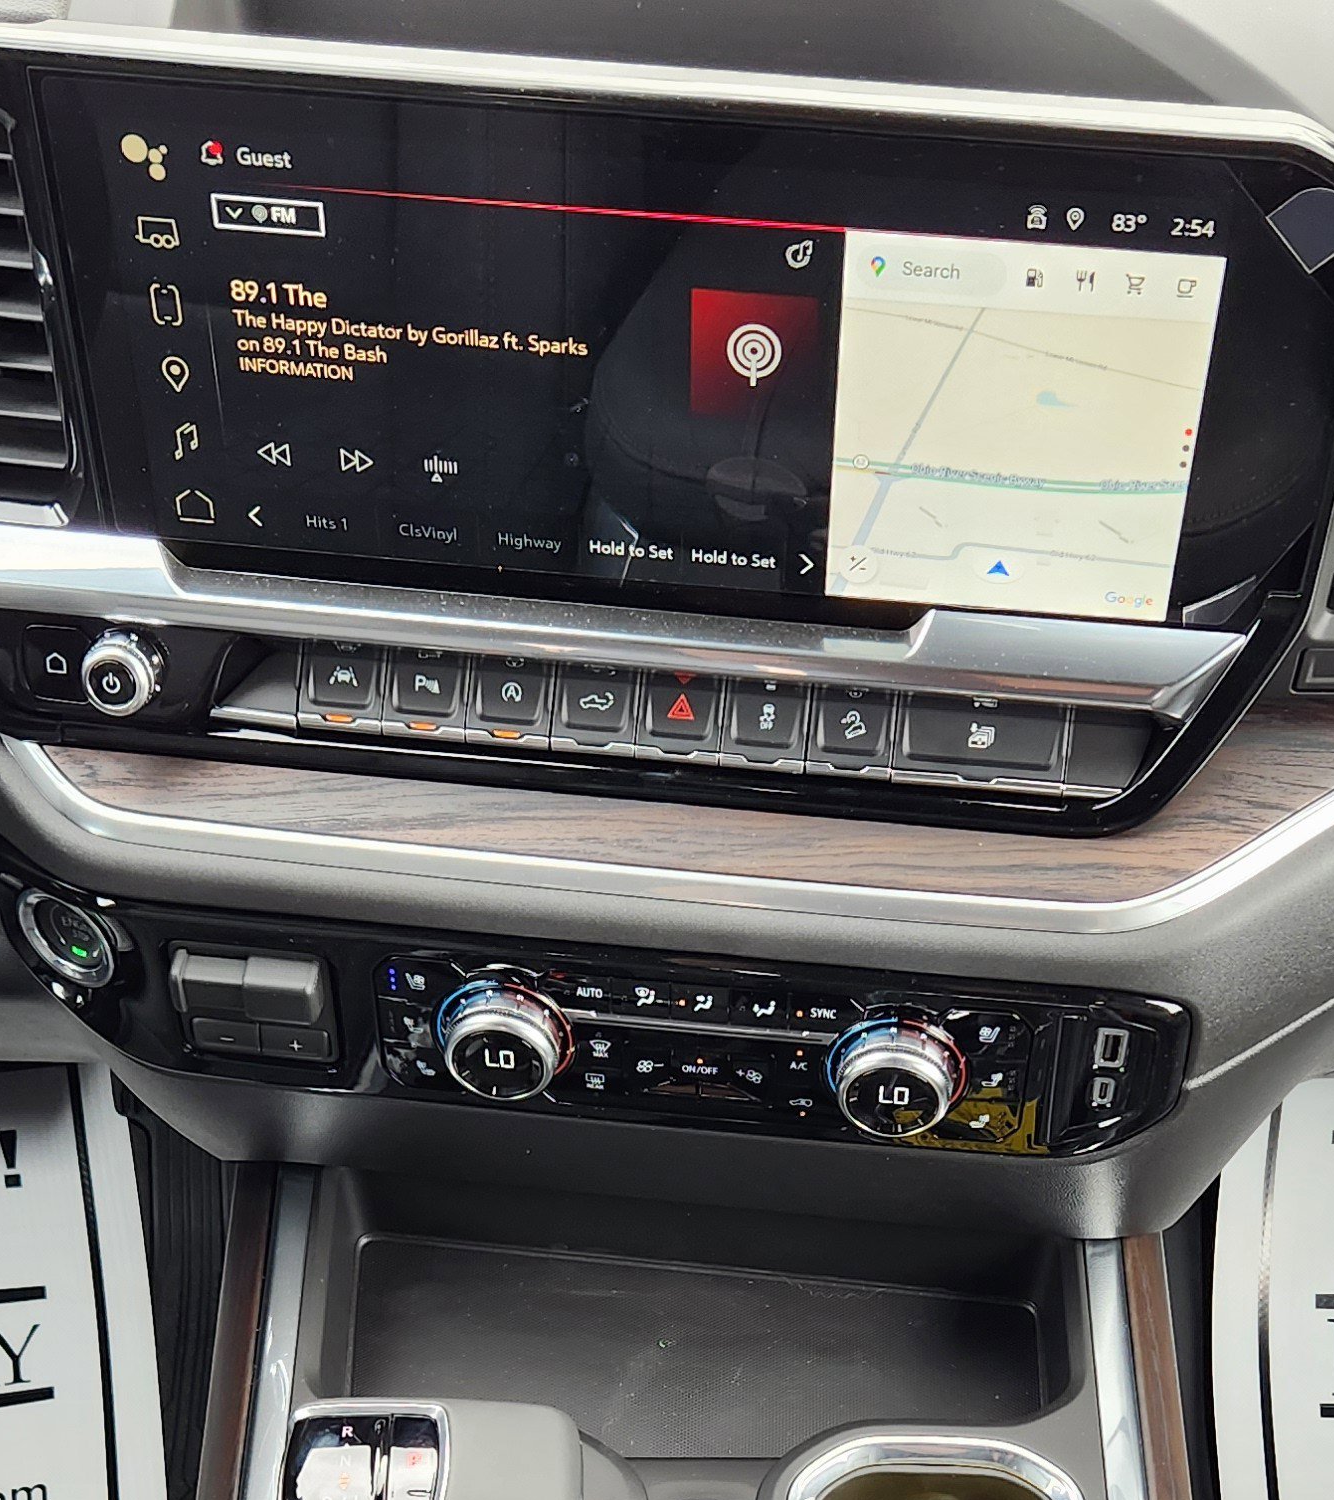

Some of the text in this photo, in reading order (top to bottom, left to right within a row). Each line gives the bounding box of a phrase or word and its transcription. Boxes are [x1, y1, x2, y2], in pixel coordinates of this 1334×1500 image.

[236, 146, 292, 169] Guest
[270, 206, 297, 225] FM
[1170, 218, 1216, 238] 2:54
[902, 261, 961, 280] Search
[230, 278, 328, 309] 89.1 The
[232, 308, 588, 357] The Happy Dictator by Gorillaz ft. Sparks
[237, 336, 388, 364] on 89.1 The Bash
[239, 356, 354, 381] INFORMATION
[305, 514, 348, 531] Hits 1
[398, 523, 458, 545] ClsVinyl
[497, 532, 562, 554] Highway
[589, 540, 674, 560] Hold to Set
[691, 549, 777, 569] Hold to Set
[1104, 591, 1153, 608] Google
[576, 986, 603, 998] AUTO
[810, 1007, 837, 1020] SYNC
[485, 1048, 515, 1069] LO
[789, 1060, 808, 1072] A/C
[681, 1064, 719, 1075] ON/OFF
[879, 1085, 910, 1105] LO
[341, 1426, 354, 1438] R
